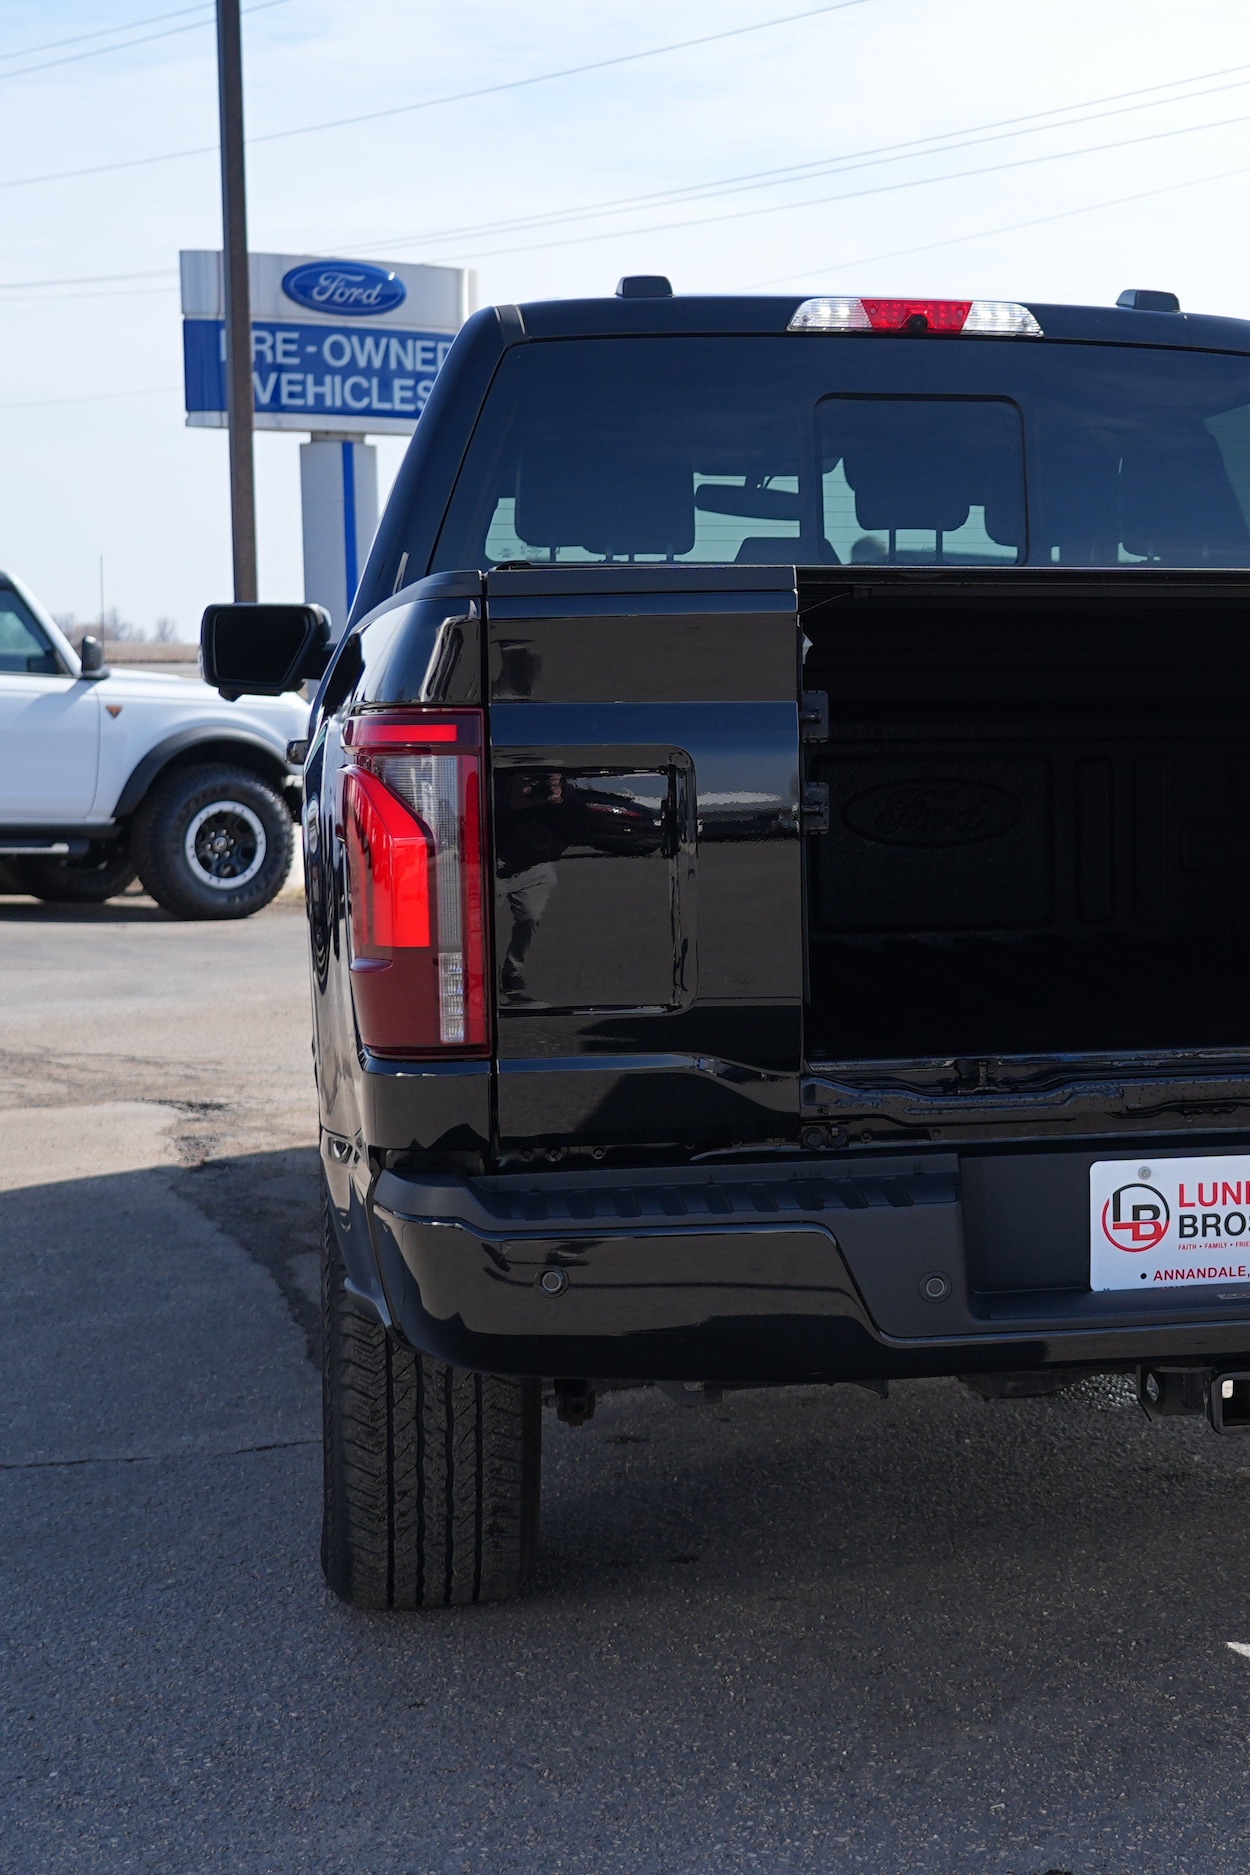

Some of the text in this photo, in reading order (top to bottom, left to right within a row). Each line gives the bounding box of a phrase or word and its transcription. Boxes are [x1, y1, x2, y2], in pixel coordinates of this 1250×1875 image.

[312, 271, 383, 305] Ford
[219, 328, 450, 374] RE-OWNE
[1178, 1243, 1197, 1251] FAITH
[1204, 1241, 1228, 1249] FAMILY
[1153, 1265, 1250, 1282] ANNANDALE,
